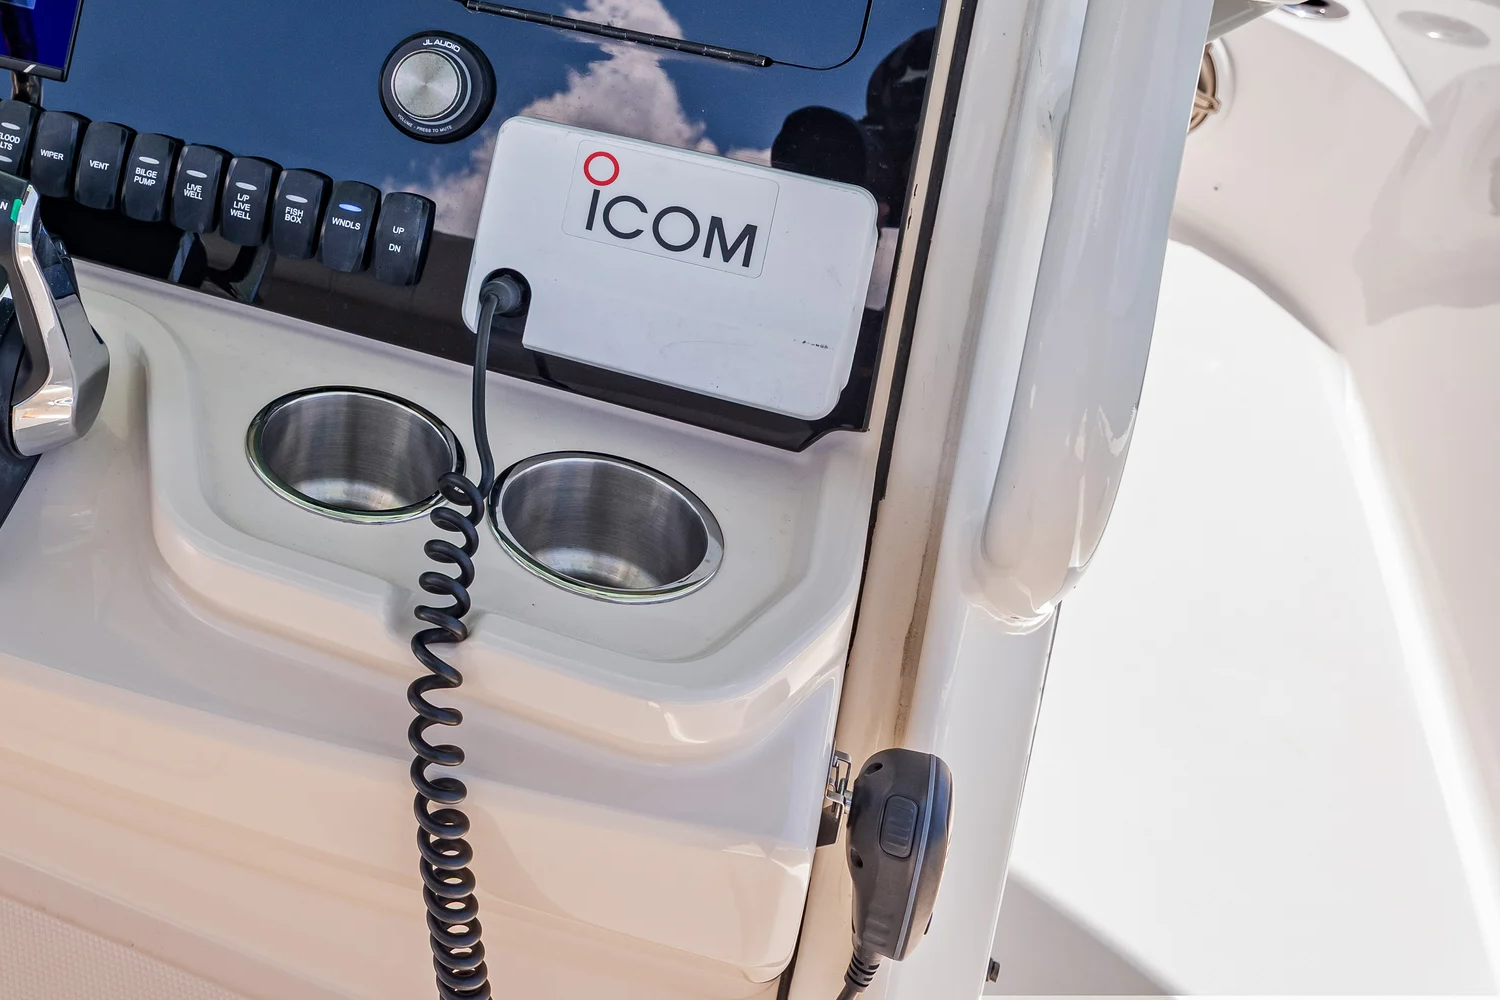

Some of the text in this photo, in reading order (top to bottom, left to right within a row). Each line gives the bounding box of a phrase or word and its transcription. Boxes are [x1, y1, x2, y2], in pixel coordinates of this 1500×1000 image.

[434, 39, 460, 53] AUDIO
[398, 114, 413, 128] VOLUME
[0, 141, 13, 150] LTS
[40, 149, 64, 160] WIPER
[89, 160, 109, 170] VENT
[135, 167, 157, 178] BILGE
[134, 176, 156, 186] PUMP
[186, 182, 202, 192] LIVE
[184, 189, 202, 200] WELL
[237, 193, 250, 202] L/P
[0, 201, 8, 210] N
[233, 201, 250, 211] LIVE
[230, 208, 251, 220] WELL
[285, 206, 303, 217] FISH
[284, 213, 302, 224] BOX
[332, 217, 361, 230] WNDLS
[392, 225, 405, 234] UP
[388, 243, 401, 252] DN
